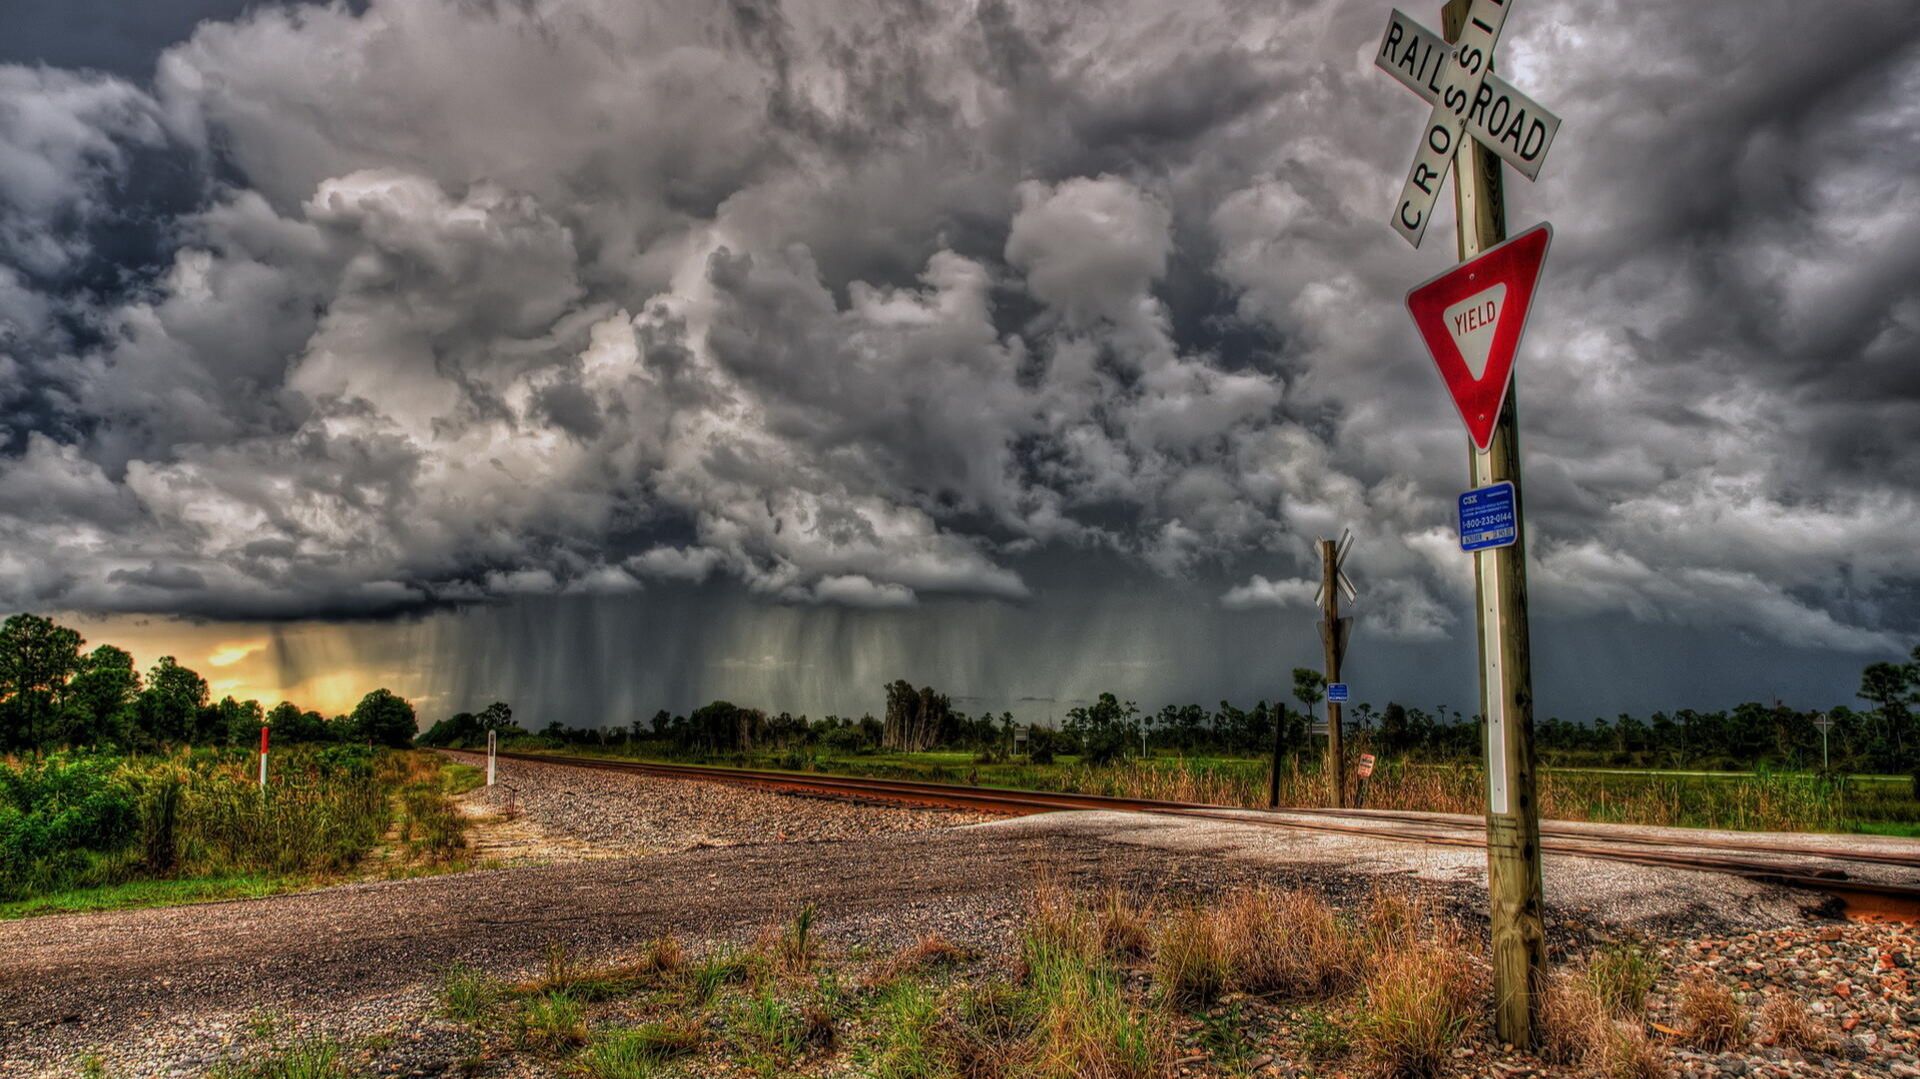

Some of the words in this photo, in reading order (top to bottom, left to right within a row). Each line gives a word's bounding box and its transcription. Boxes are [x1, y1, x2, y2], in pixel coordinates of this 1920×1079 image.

[1382, 21, 1444, 95] RAIL
[1469, 80, 1547, 162] ROAD
[1401, 0, 1503, 231] CROSSI
[1454, 300, 1496, 337] YIELD
[1463, 495, 1478, 505] CSX
[1462, 512, 1512, 529] 1-800-232-0144
